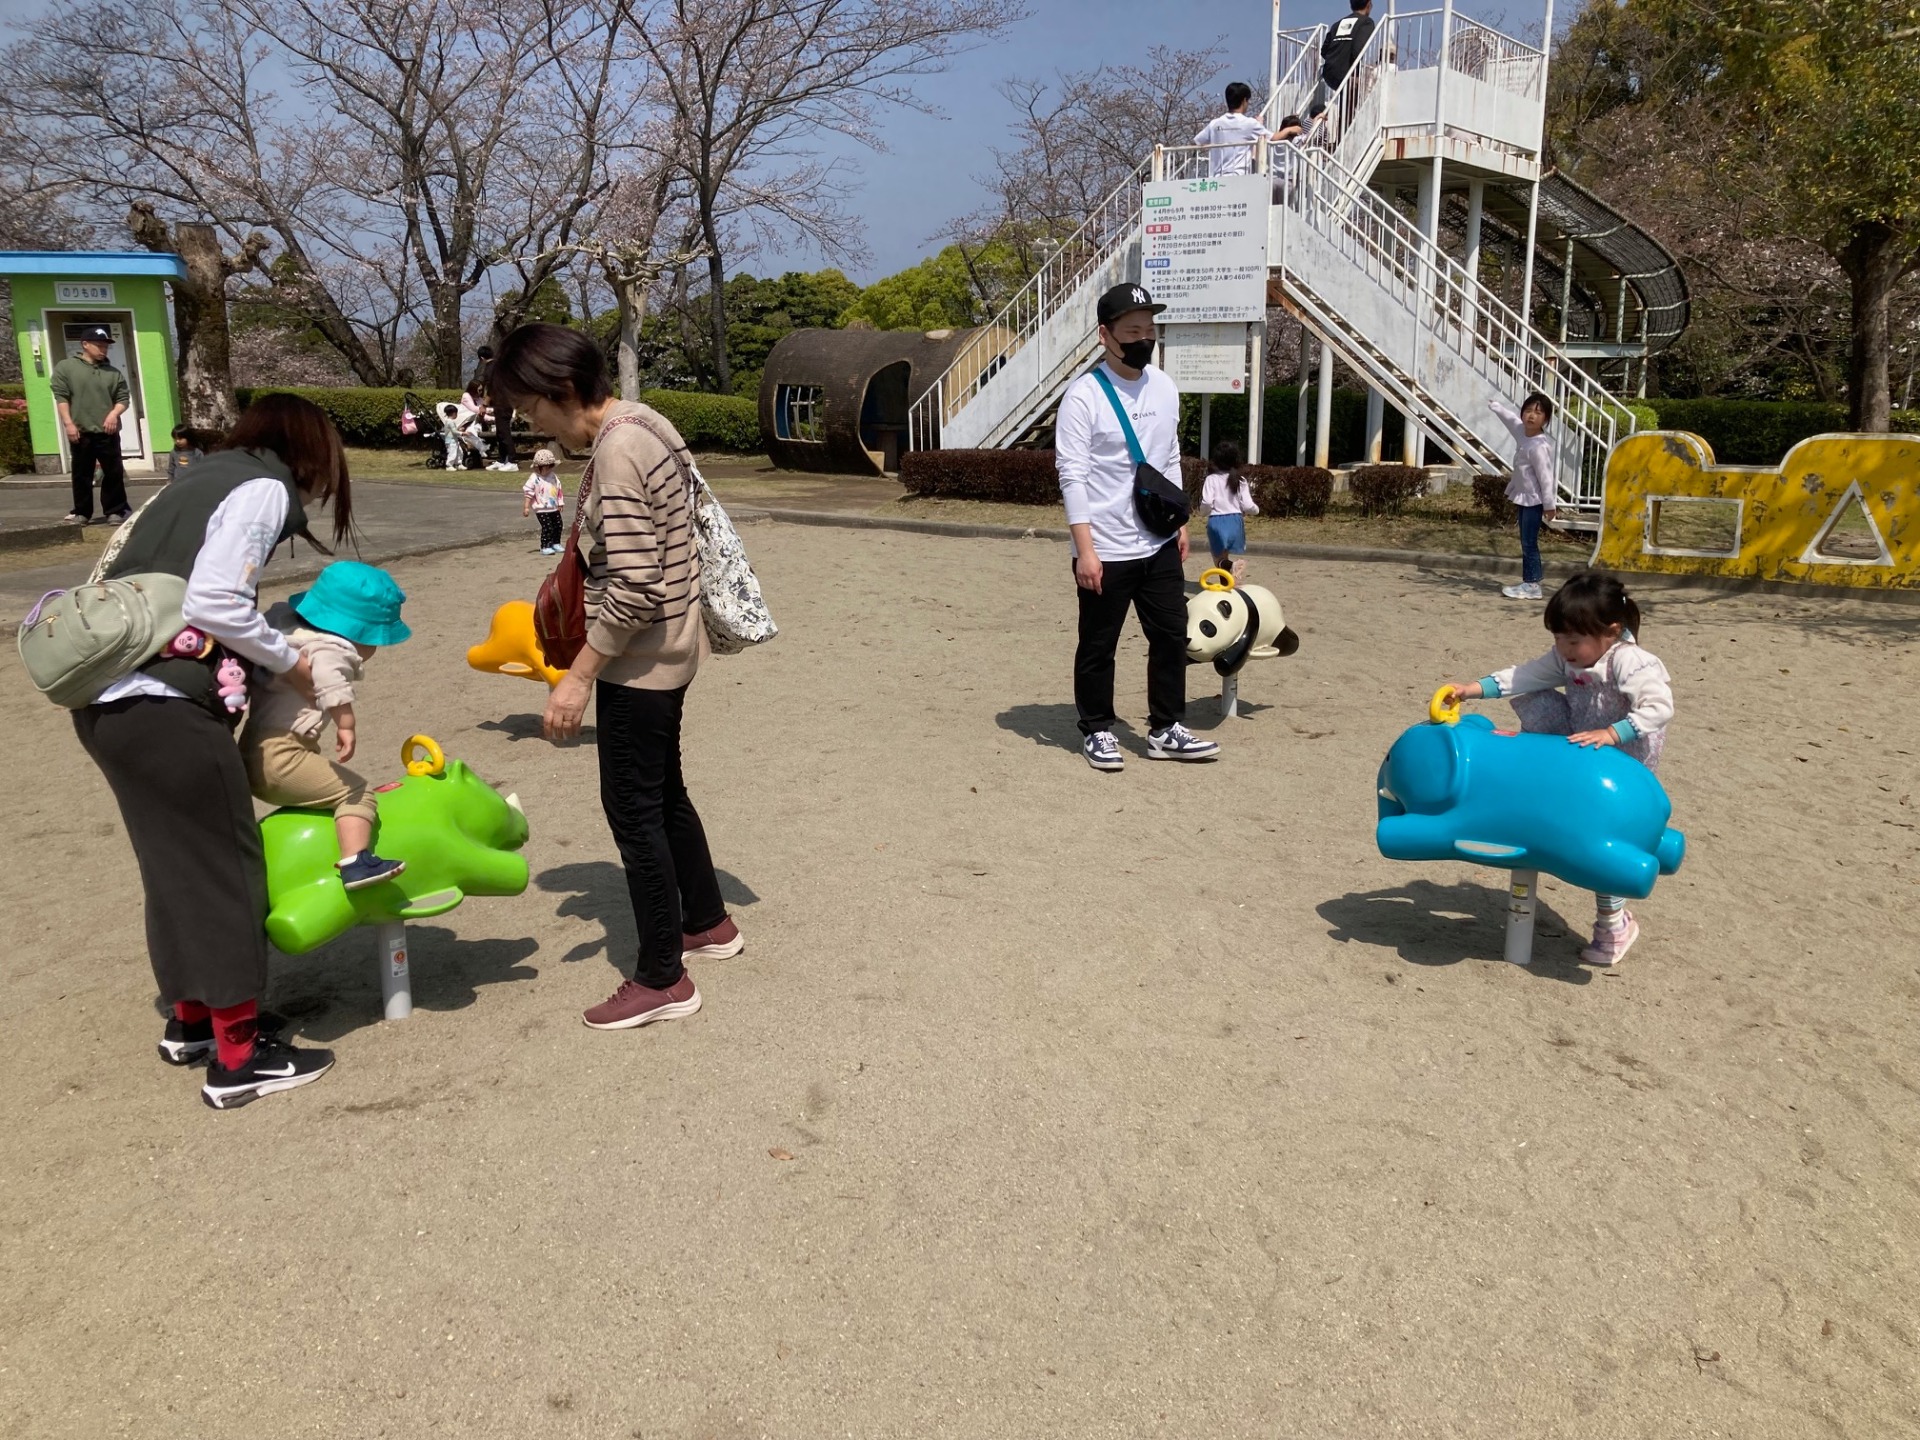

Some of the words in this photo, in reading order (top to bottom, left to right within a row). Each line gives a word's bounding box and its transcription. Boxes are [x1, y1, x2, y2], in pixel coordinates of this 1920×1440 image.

[1147, 225, 1169, 233] 休園日
[1131, 288, 1146, 303] NY
